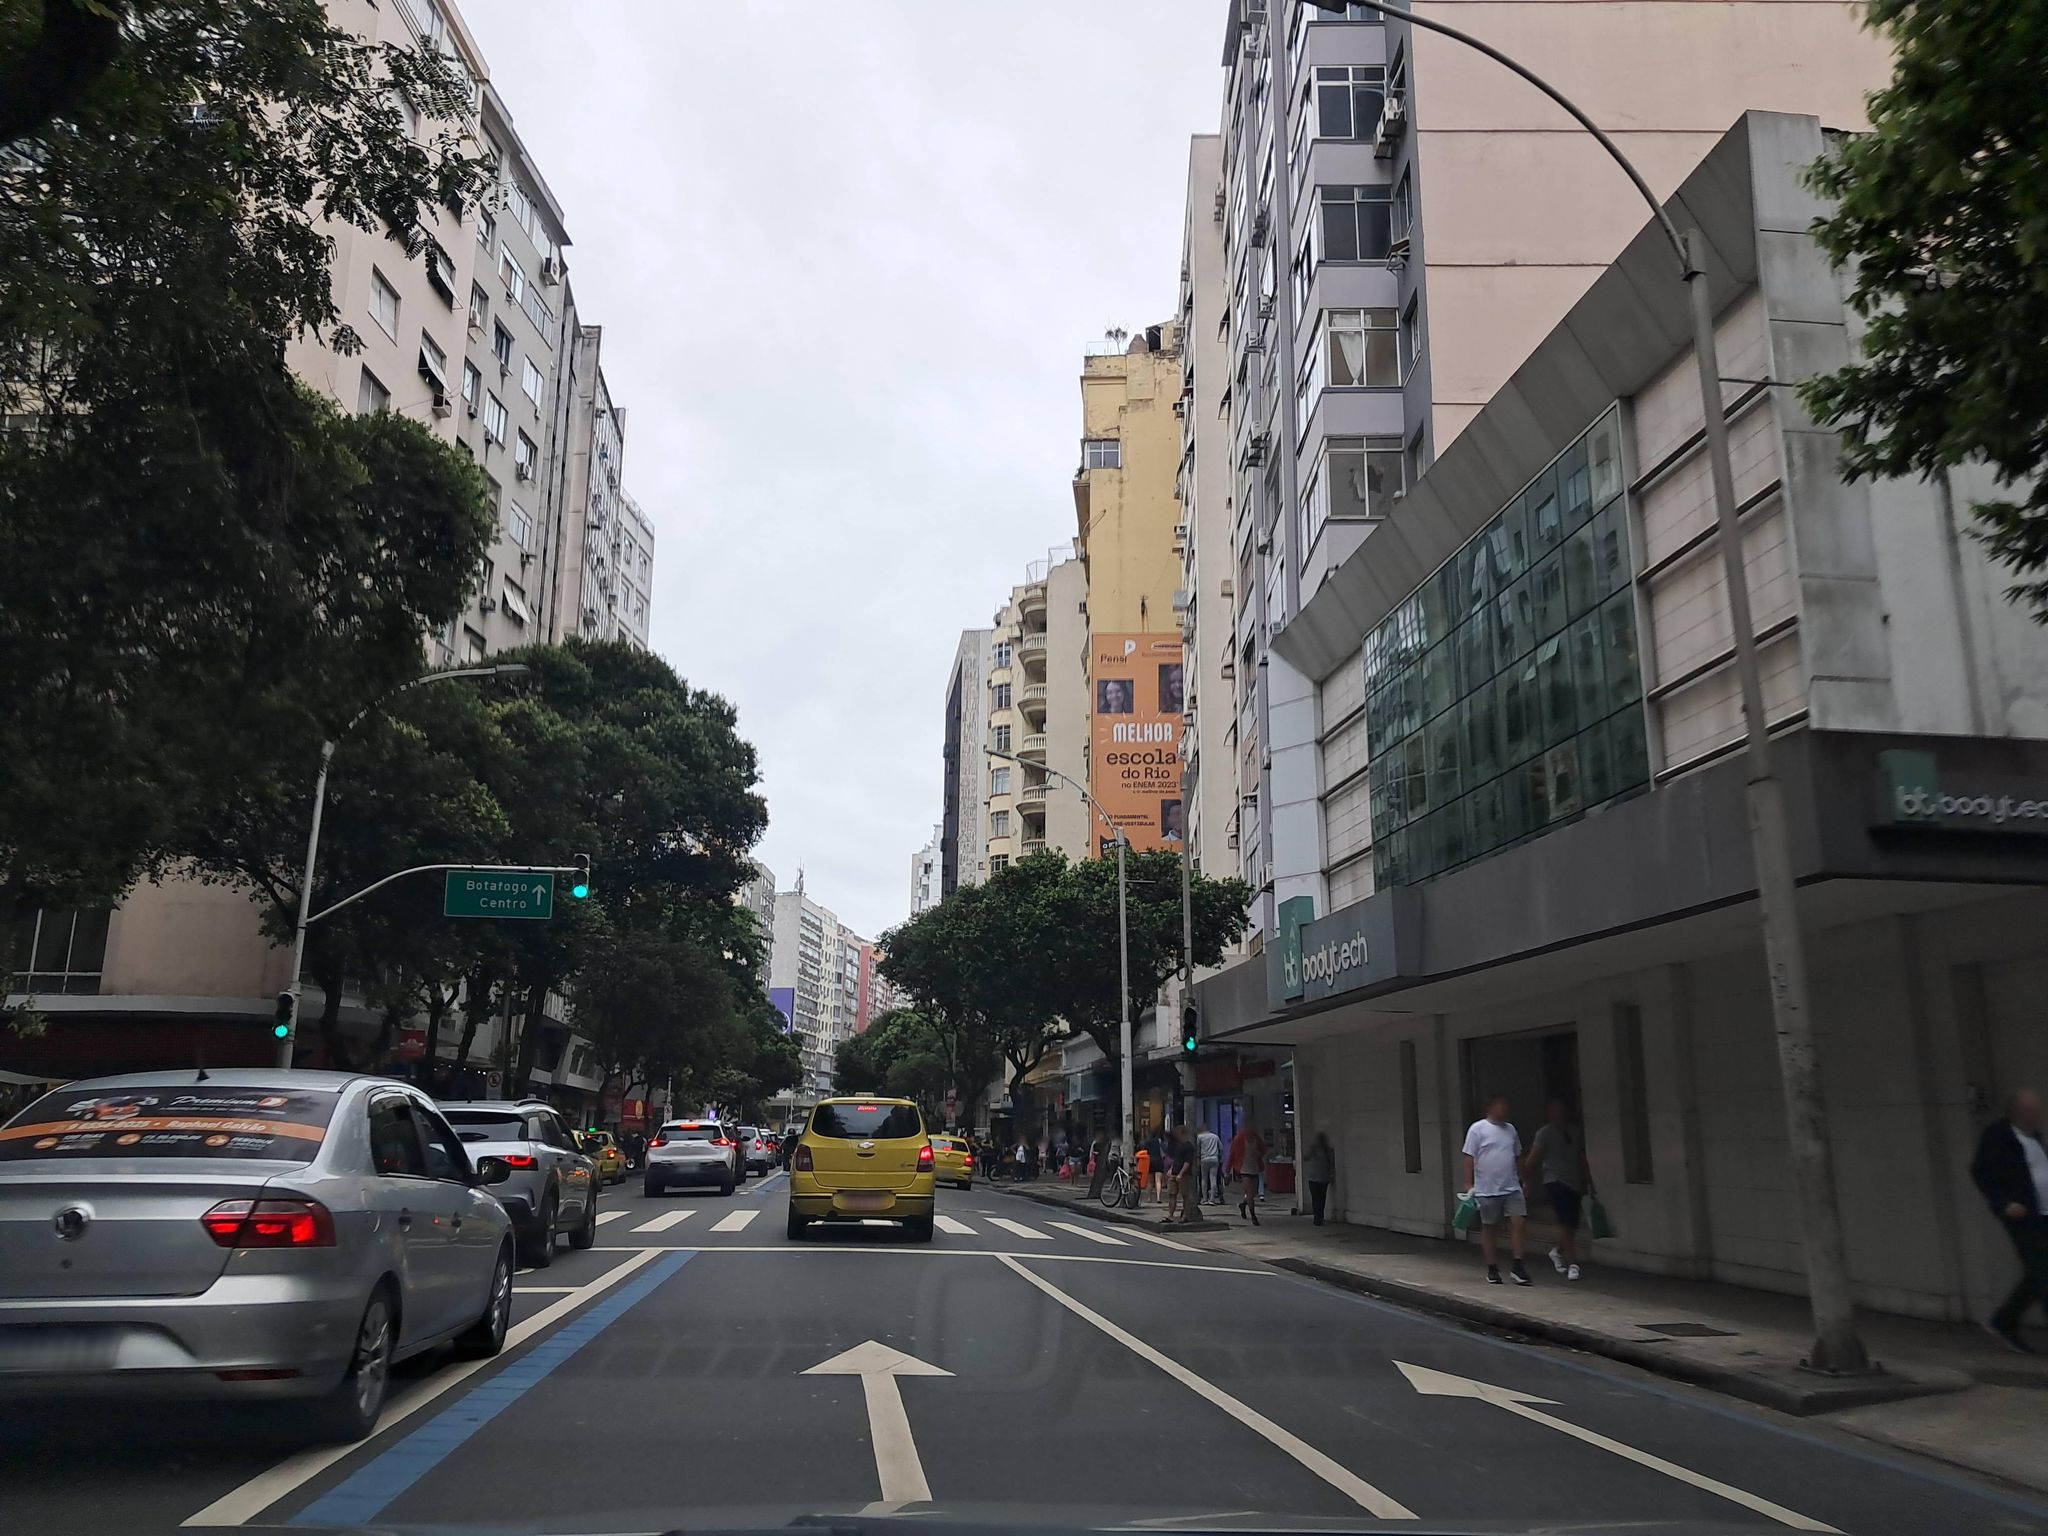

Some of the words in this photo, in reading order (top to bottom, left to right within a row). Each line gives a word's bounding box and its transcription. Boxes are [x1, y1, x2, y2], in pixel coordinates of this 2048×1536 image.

[1113, 722, 1172, 742] MELHOR
[1106, 748, 1176, 765] escola
[1121, 767, 1140, 779] do
[1144, 767, 1170, 779] Rio
[466, 880, 528, 895] Botafogo
[479, 898, 527, 909] Centro
[1301, 930, 1368, 987] bodytech
[170, 1095, 258, 1106] Premium
